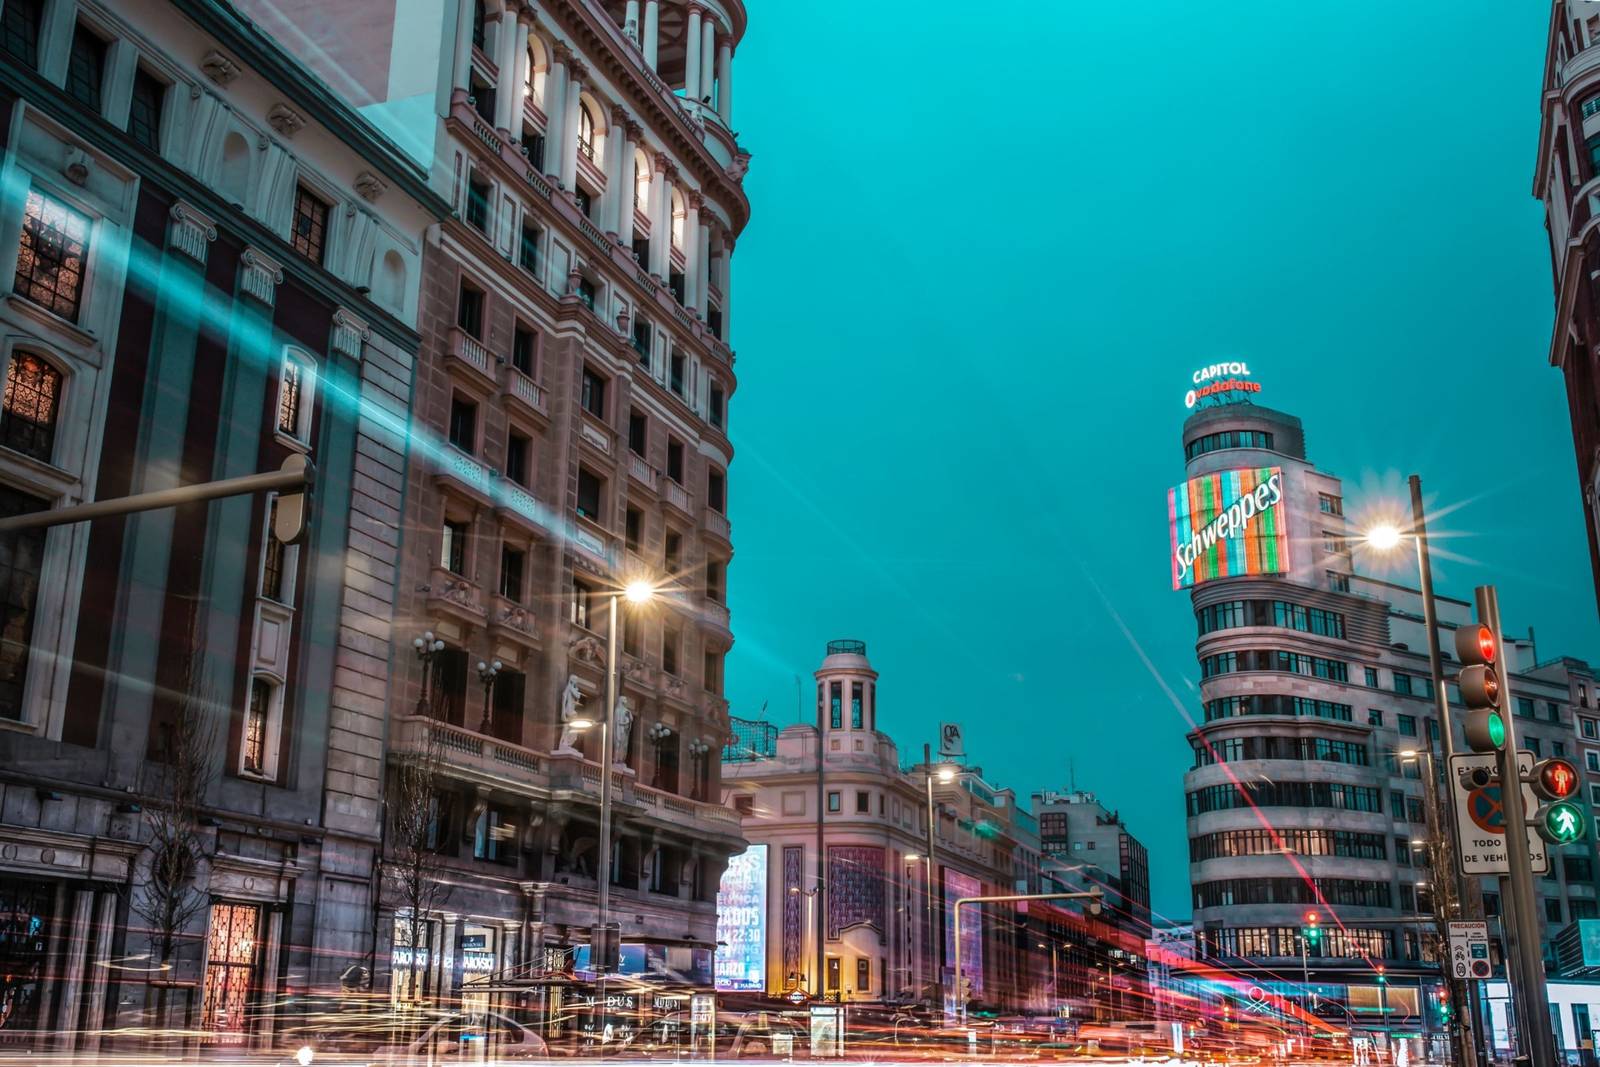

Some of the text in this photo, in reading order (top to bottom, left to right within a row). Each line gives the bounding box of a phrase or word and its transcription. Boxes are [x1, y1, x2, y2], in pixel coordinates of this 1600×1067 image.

[1192, 361, 1251, 384] CAPITOL
[1195, 377, 1262, 399] vodafone
[1175, 473, 1281, 580] Schweppes
[1472, 839, 1502, 847] TODO
[1464, 854, 1478, 863] DE
[585, 996, 633, 1007] MDUS
